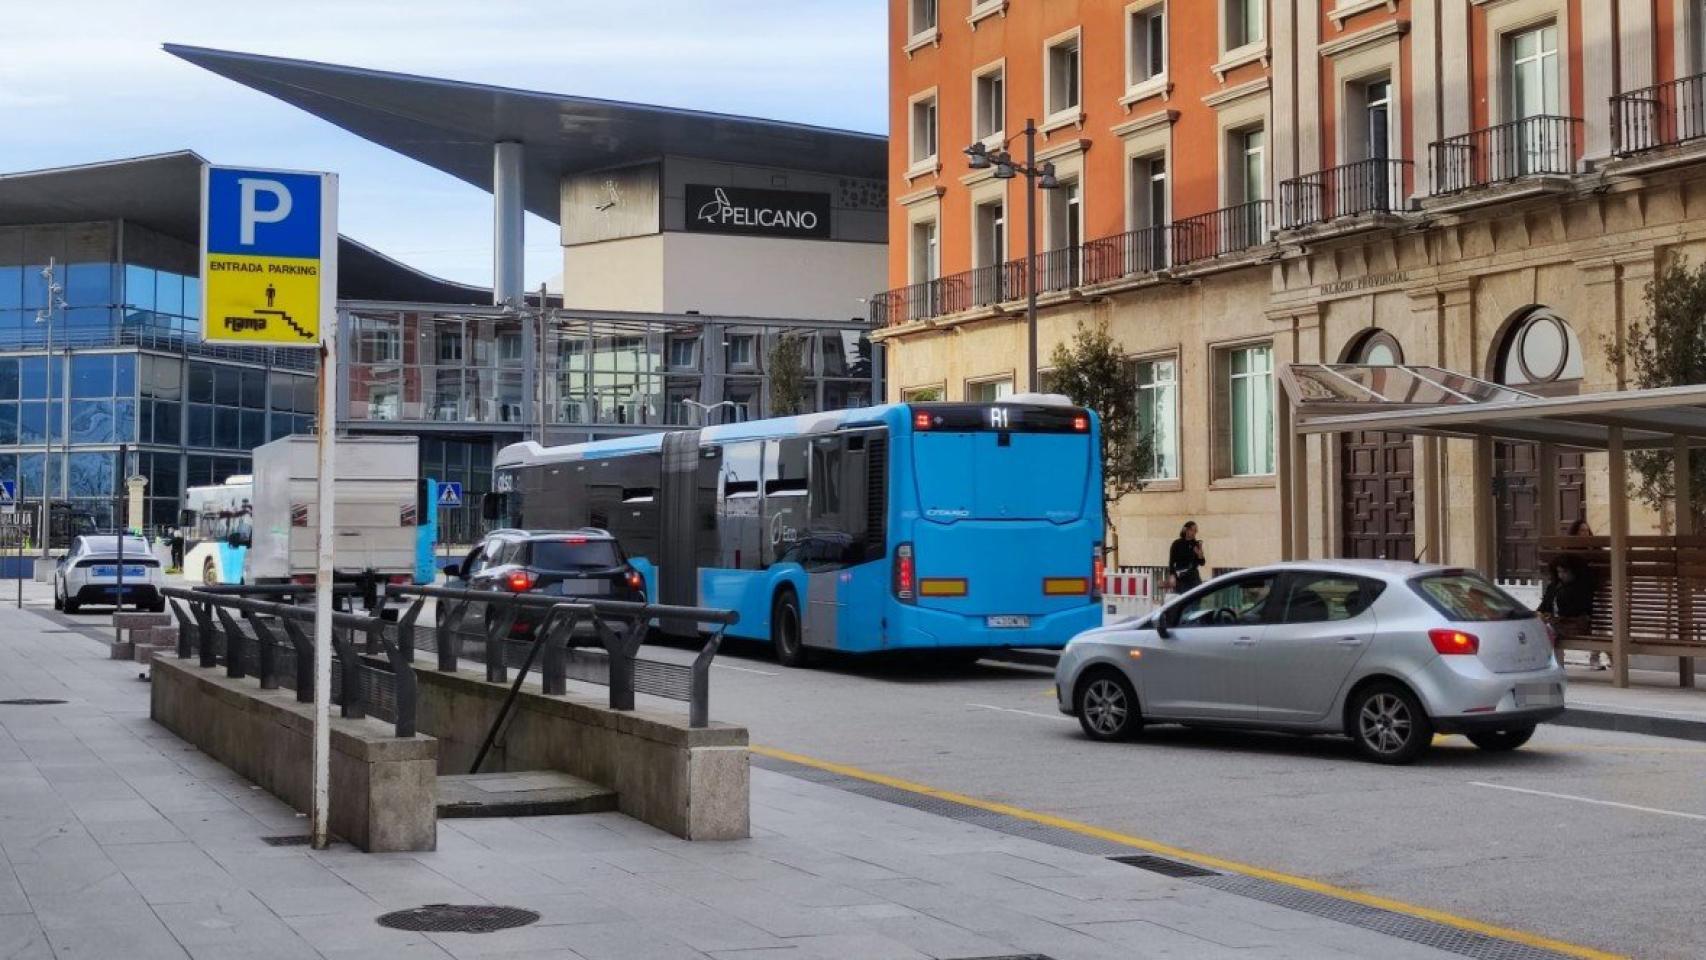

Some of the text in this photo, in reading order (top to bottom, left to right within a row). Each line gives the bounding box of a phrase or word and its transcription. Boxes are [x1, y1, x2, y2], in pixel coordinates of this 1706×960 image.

[238, 177, 293, 246] P
[721, 206, 818, 229] PELICANO
[210, 261, 317, 275] ENTRADA PARKING
[991, 407, 1008, 428] R1
